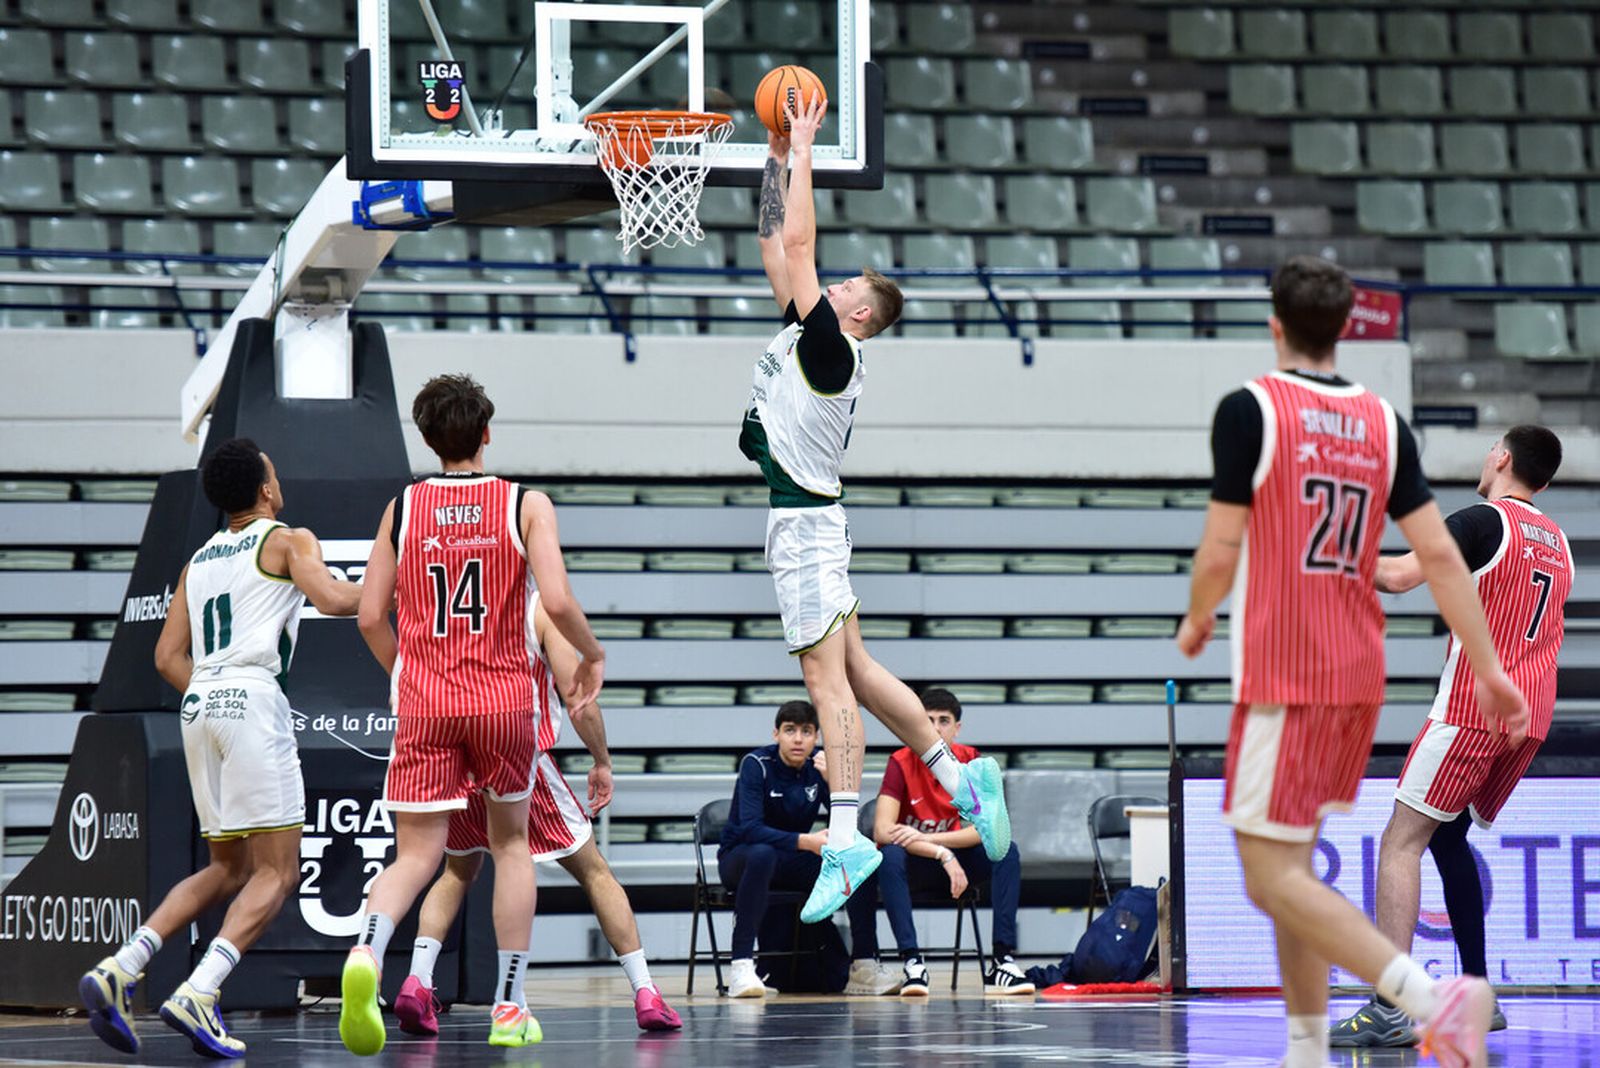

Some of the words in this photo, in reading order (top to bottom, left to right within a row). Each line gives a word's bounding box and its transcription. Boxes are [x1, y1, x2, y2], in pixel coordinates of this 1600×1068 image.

[420, 63, 463, 79] LIGA
[434, 504, 483, 527] NEVES
[1301, 474, 1374, 579] 20
[446, 534, 499, 547] CaixaBank
[426, 558, 488, 638] 14
[1523, 568, 1554, 641] 7
[203, 592, 233, 657] 11
[205, 701, 222, 711] DEL
[224, 700, 247, 711] SOL
[208, 688, 248, 700] COSTA
[312, 714, 337, 731] de
[342, 715, 360, 731] la
[103, 812, 140, 839] LABASA
[39, 896, 68, 942] GO
[71, 897, 142, 944] BEYOND
